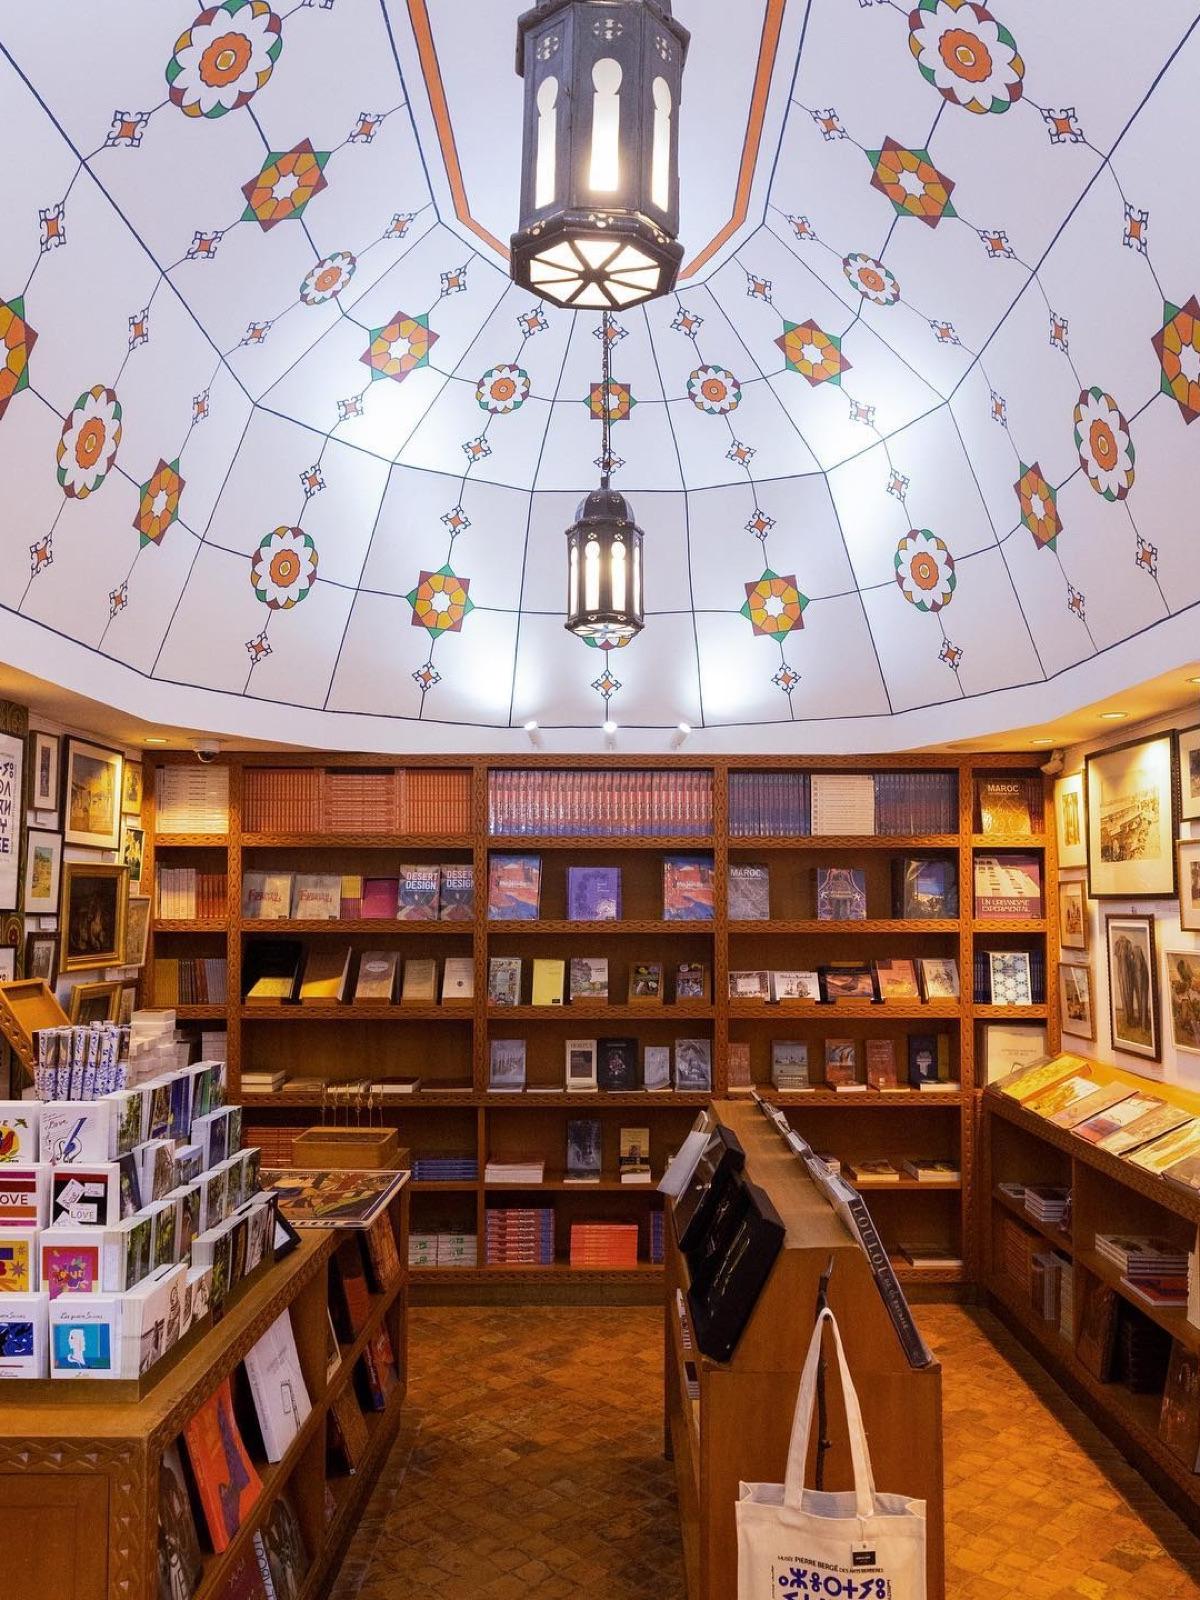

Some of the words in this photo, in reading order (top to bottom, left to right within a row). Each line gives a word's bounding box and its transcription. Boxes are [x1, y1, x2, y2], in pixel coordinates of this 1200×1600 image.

[988, 784, 1019, 792] MAROC
[406, 871, 438, 880] DESERT
[730, 868, 761, 877] MAROC
[405, 880, 436, 890] DESIGN
[446, 879, 473, 888] DESIG
[70, 1211, 94, 1219] LOVE
[794, 1556, 816, 1566] PIERRE
[817, 1559, 839, 1572] BERGÉ
